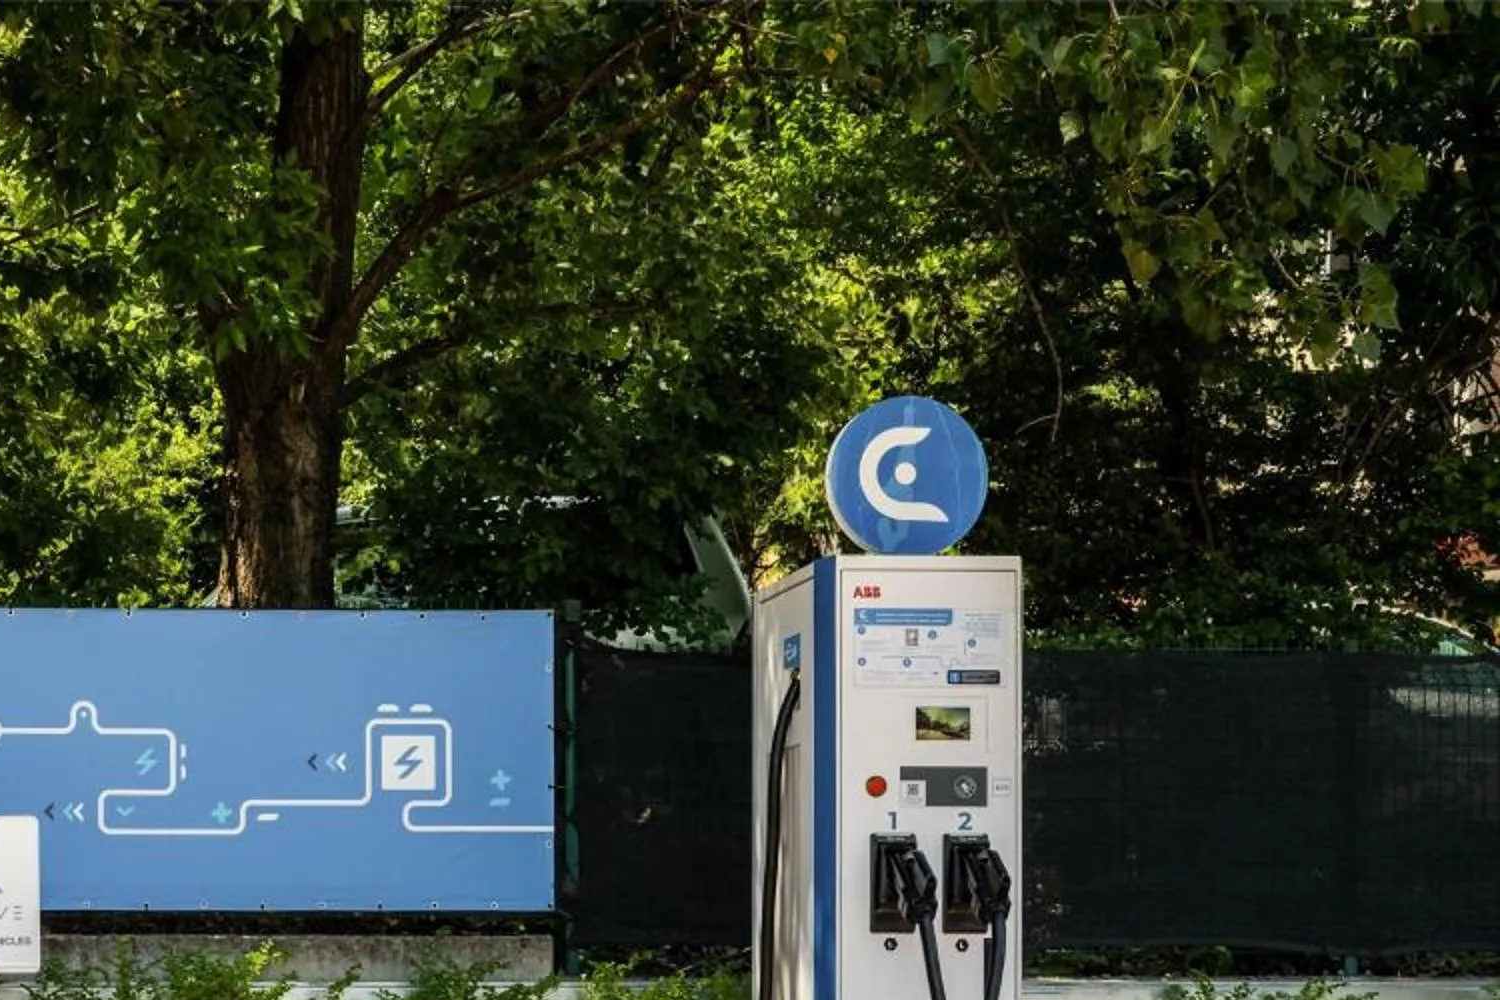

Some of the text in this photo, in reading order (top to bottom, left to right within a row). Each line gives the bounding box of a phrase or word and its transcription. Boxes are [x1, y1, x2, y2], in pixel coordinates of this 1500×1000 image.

[853, 585, 882, 599] ABB
[887, 811, 898, 831] 1
[957, 811, 973, 831] 2
